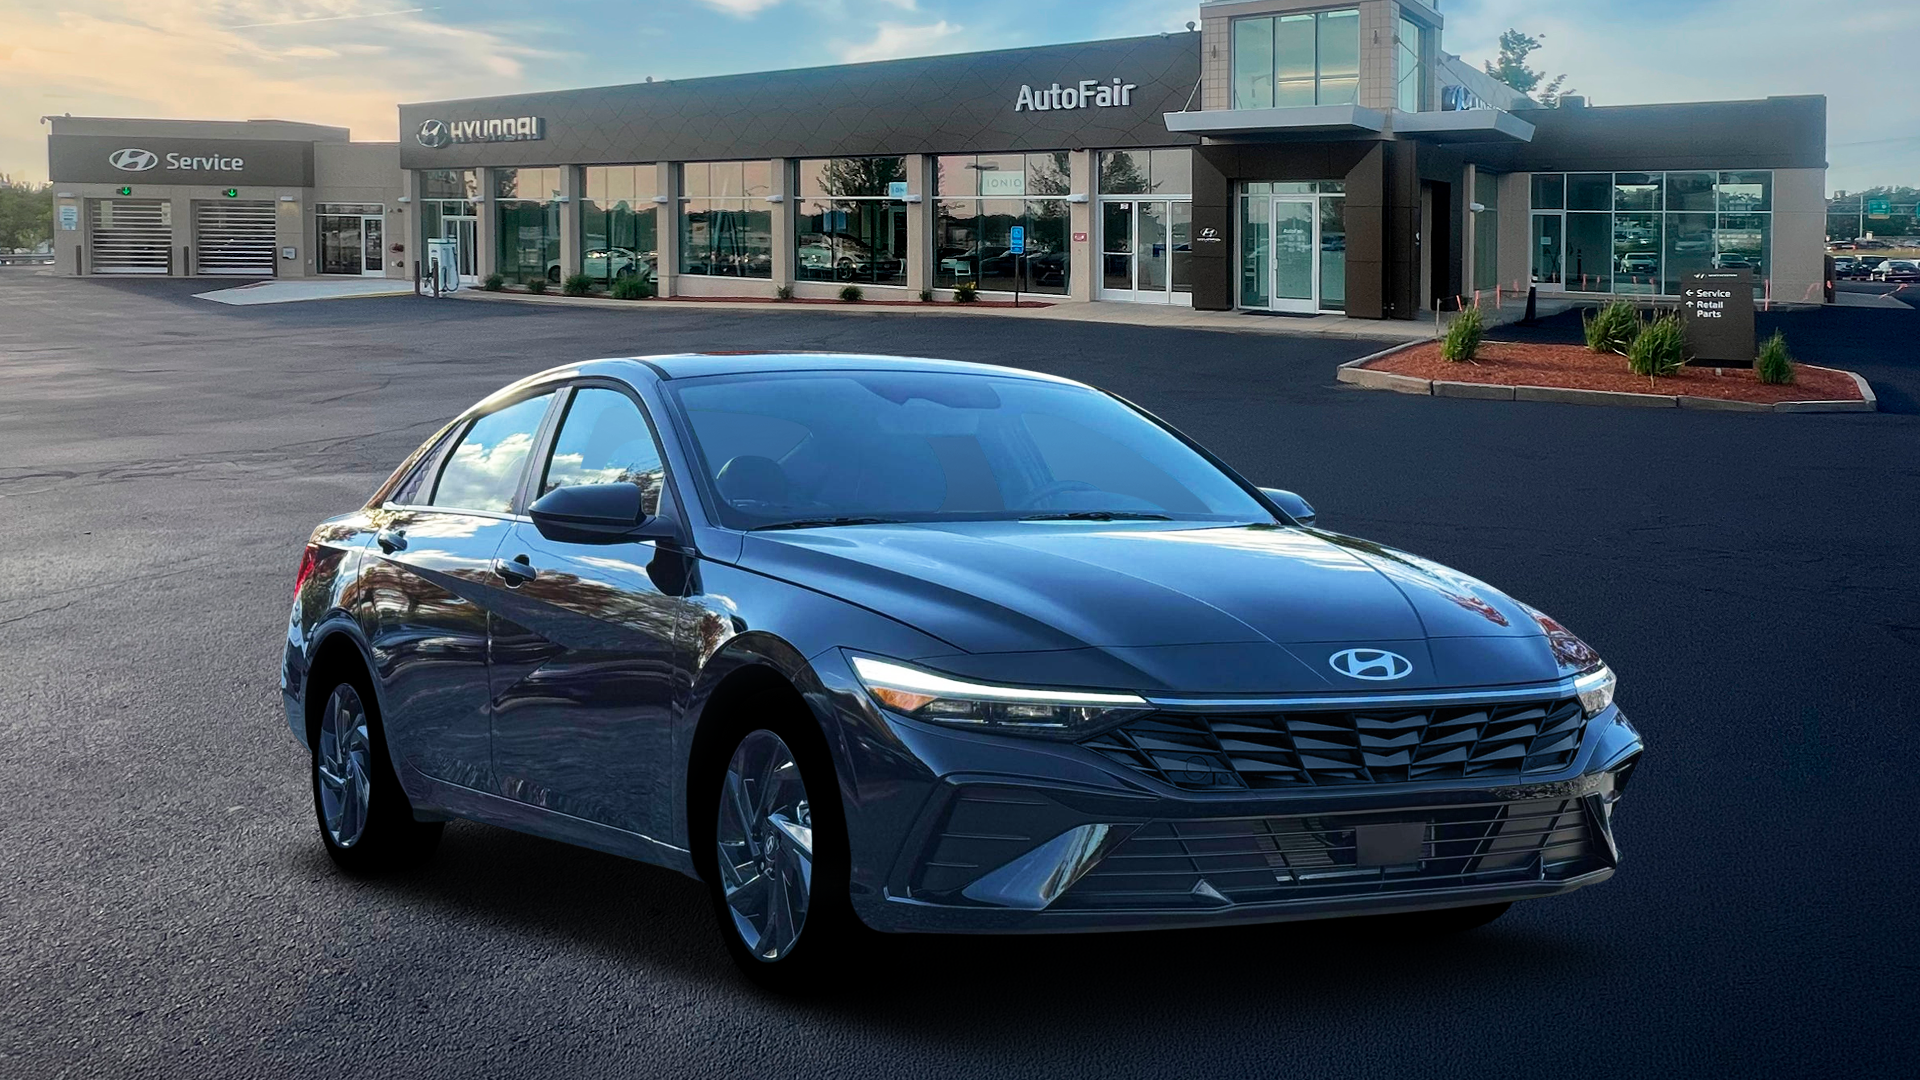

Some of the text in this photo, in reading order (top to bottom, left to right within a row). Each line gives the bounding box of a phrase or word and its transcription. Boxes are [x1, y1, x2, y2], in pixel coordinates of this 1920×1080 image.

[1015, 77, 1137, 112] AutoFair
[450, 116, 542, 142] HYUNDAI
[166, 152, 244, 171] Service
[1696, 289, 1731, 298] Service
[1696, 301, 1724, 309] Retail
[1696, 309, 1722, 318] Parts
